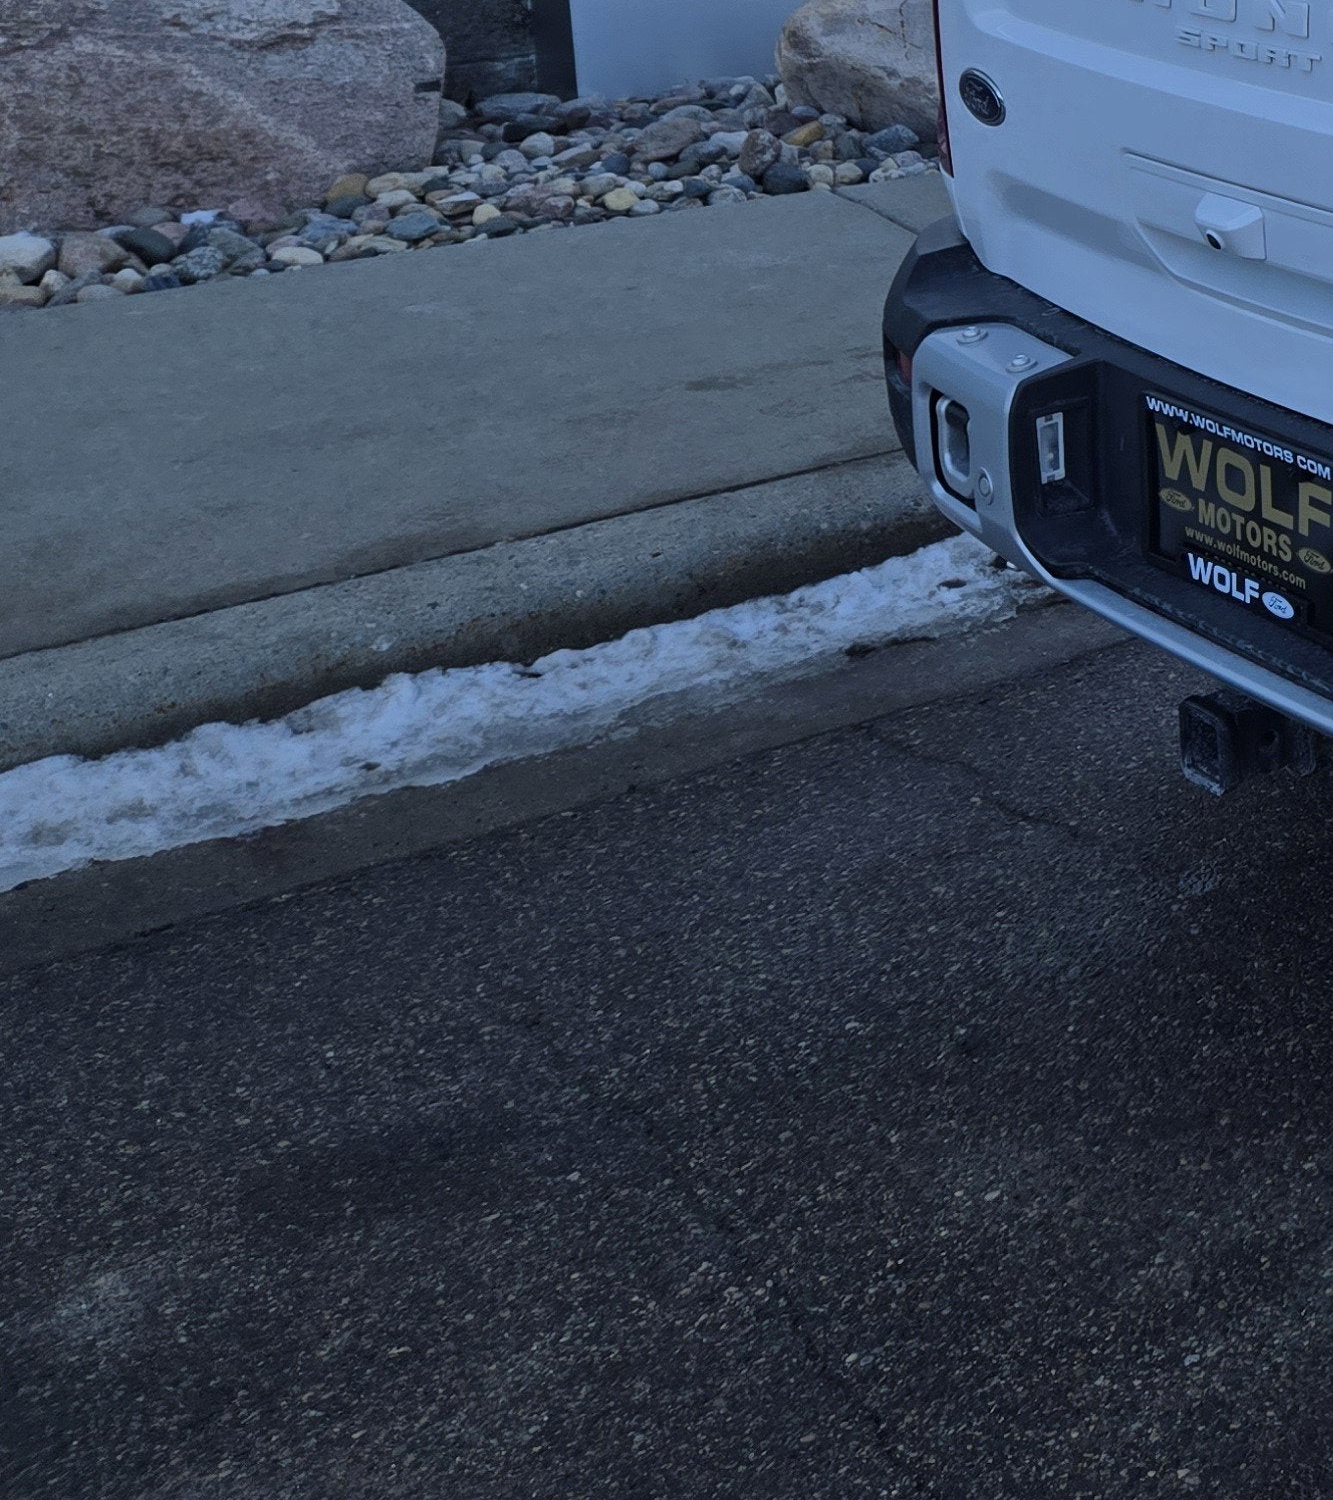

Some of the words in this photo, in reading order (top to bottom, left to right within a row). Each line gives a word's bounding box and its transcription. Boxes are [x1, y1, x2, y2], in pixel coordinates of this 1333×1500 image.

[1175, 24, 1323, 73] SPORT
[1155, 422, 1333, 538] WOLF
[1184, 526, 1307, 590] www.wolfmotors.com
[1198, 498, 1293, 563] MOTORS
[1187, 552, 1260, 604] WOLF
